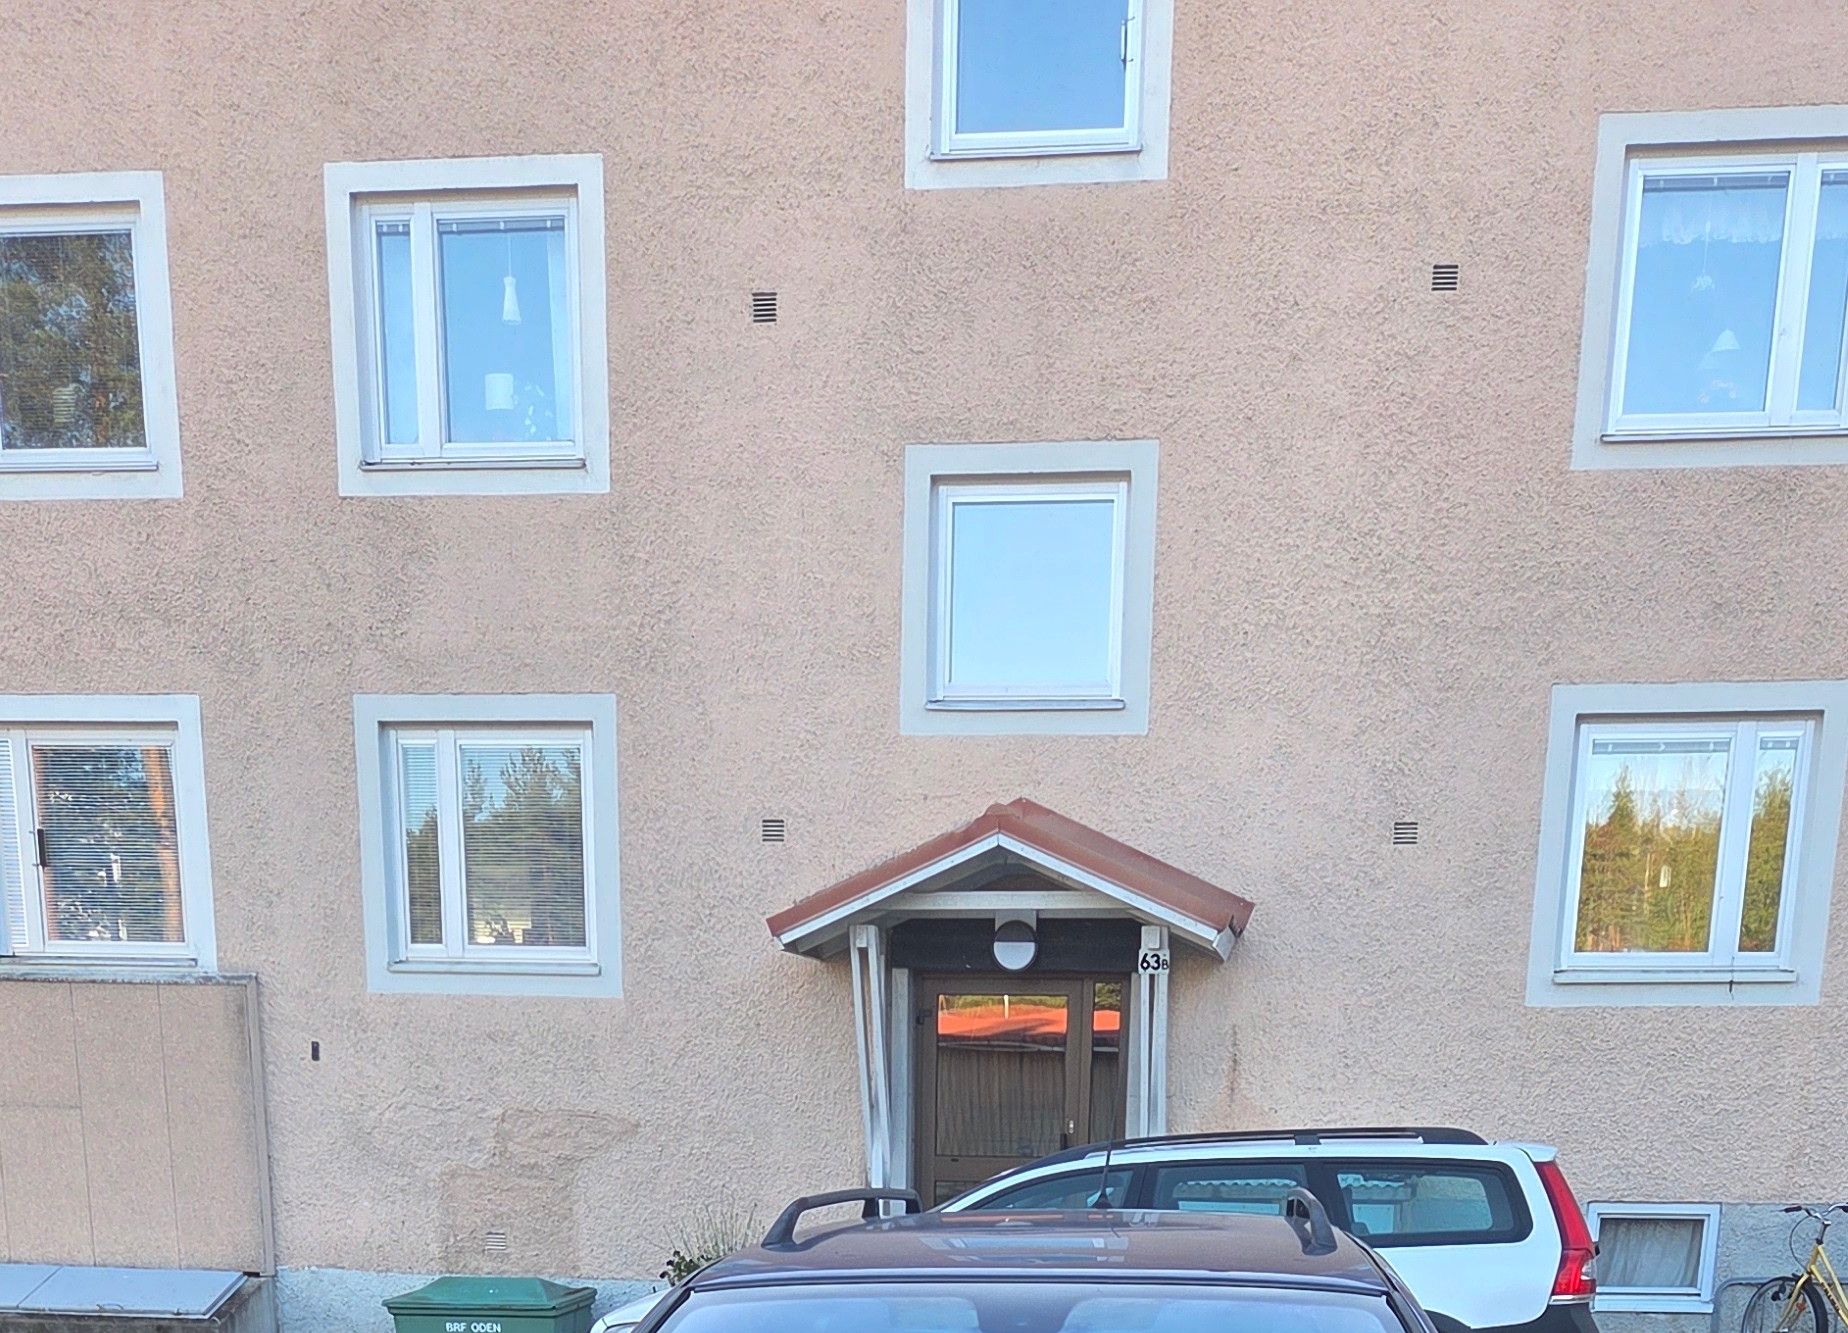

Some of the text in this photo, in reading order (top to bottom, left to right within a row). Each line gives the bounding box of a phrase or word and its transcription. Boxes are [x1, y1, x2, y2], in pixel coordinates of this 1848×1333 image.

[1140, 952, 1169, 971] 63B
[445, 1322, 501, 1333] BRF ODEN
